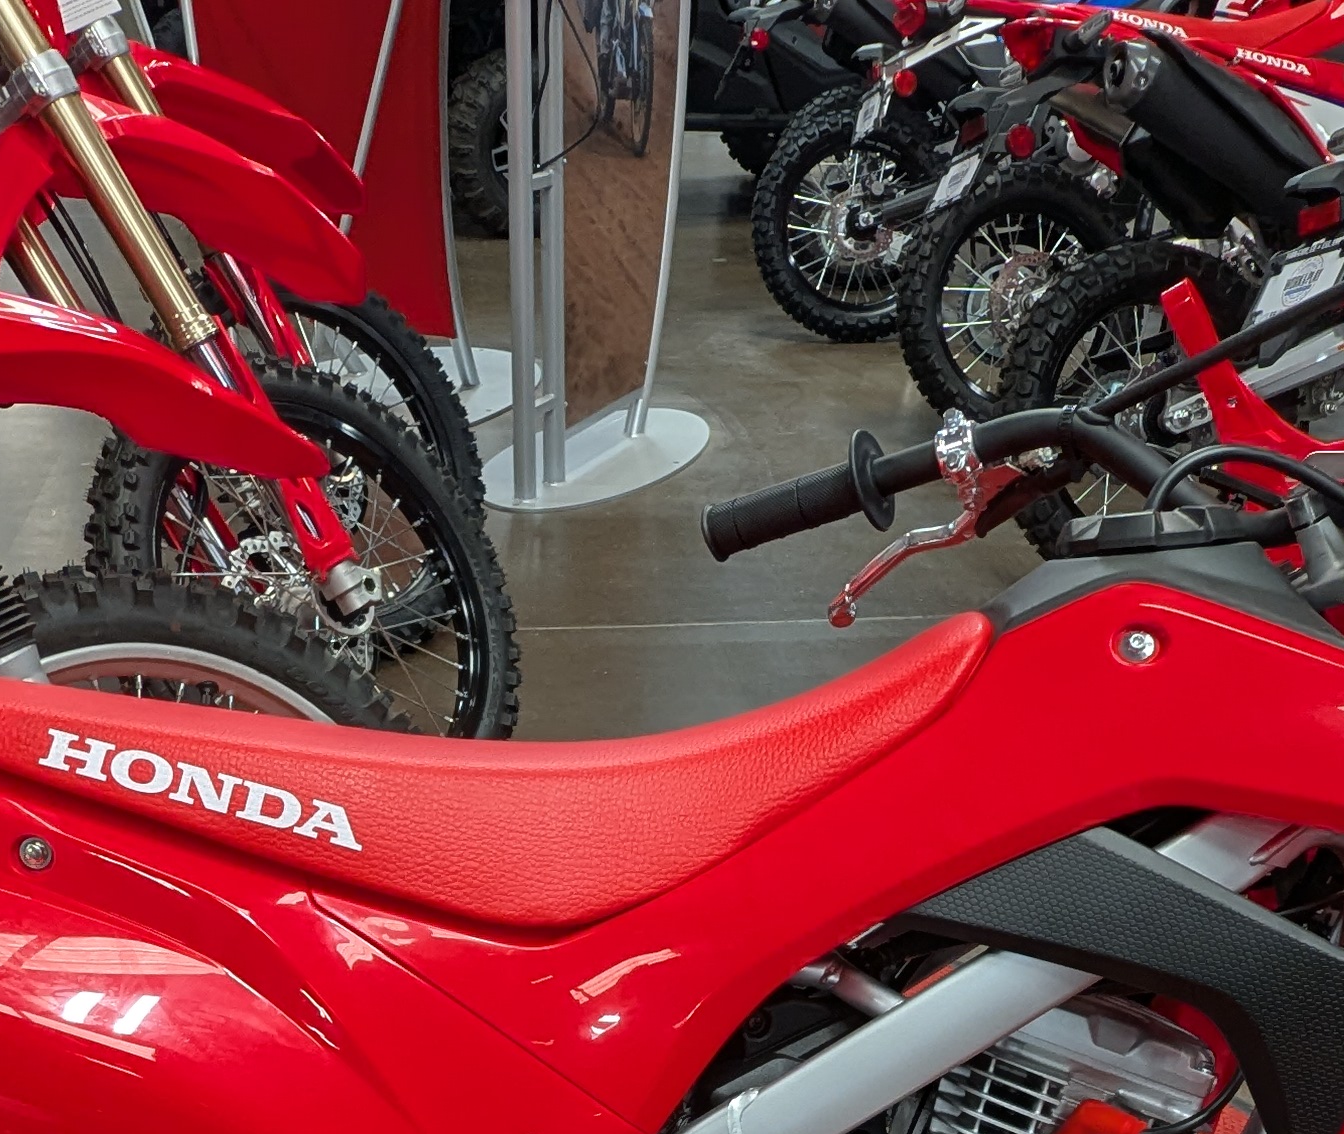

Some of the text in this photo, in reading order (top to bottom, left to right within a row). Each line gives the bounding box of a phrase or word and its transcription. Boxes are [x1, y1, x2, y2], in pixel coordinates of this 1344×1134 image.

[1111, 9, 1189, 39] HONDA
[1236, 47, 1312, 76] HONDA
[38, 728, 363, 852] HONDA
